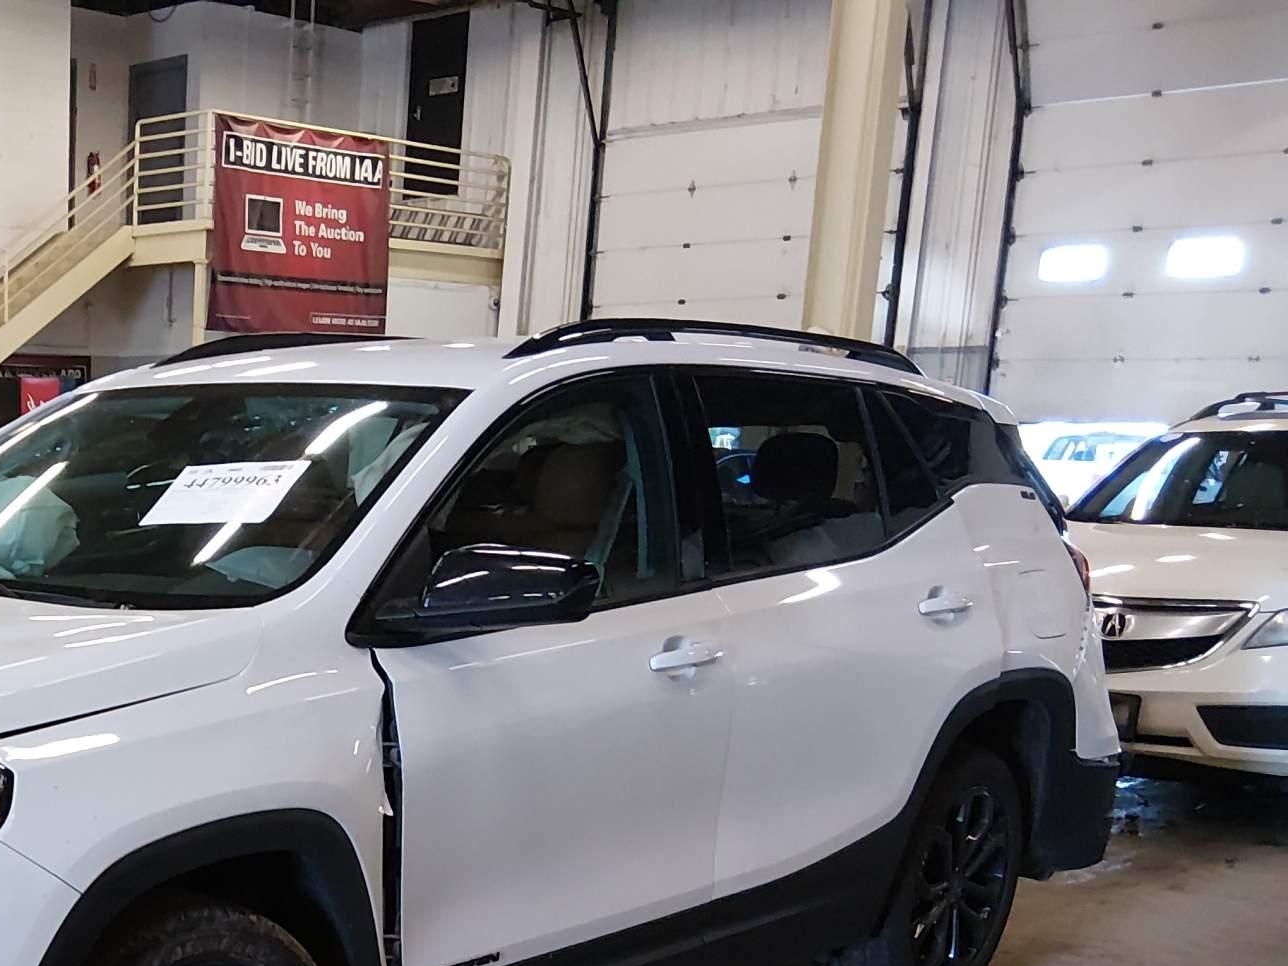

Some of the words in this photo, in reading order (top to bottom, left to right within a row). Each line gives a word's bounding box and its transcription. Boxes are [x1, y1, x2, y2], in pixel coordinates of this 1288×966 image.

[229, 138, 267, 167] I-BID
[271, 145, 306, 173] LIVE
[308, 151, 350, 180] FROM
[295, 199, 313, 217] We
[315, 203, 347, 224] Bring
[294, 220, 316, 237] The
[318, 223, 365, 242] Auction
[292, 240, 307, 256] To
[310, 241, 332, 258] You
